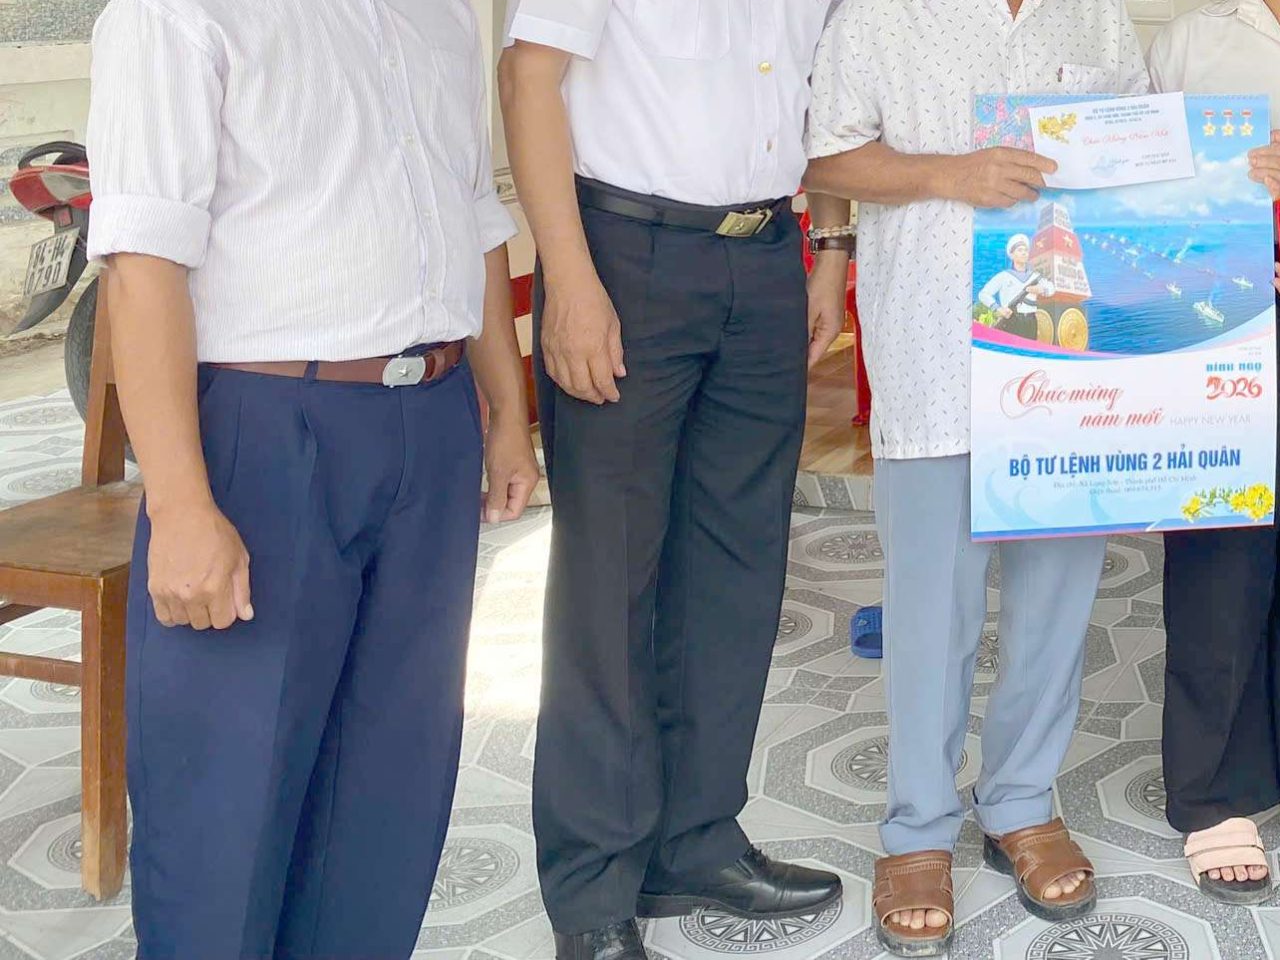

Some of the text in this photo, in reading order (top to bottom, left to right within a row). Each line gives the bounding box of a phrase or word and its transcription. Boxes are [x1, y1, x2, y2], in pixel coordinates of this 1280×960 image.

[1001, 369, 1123, 415] Chúc mừng
[1206, 376, 1263, 400] 2026
[1126, 407, 1164, 427] mới
[1169, 414, 1251, 426] HAPPY NEW YEAR
[1009, 443, 1241, 480] BỘ TƯ LỆNH VÙNG 2 HẢI QUÂN
